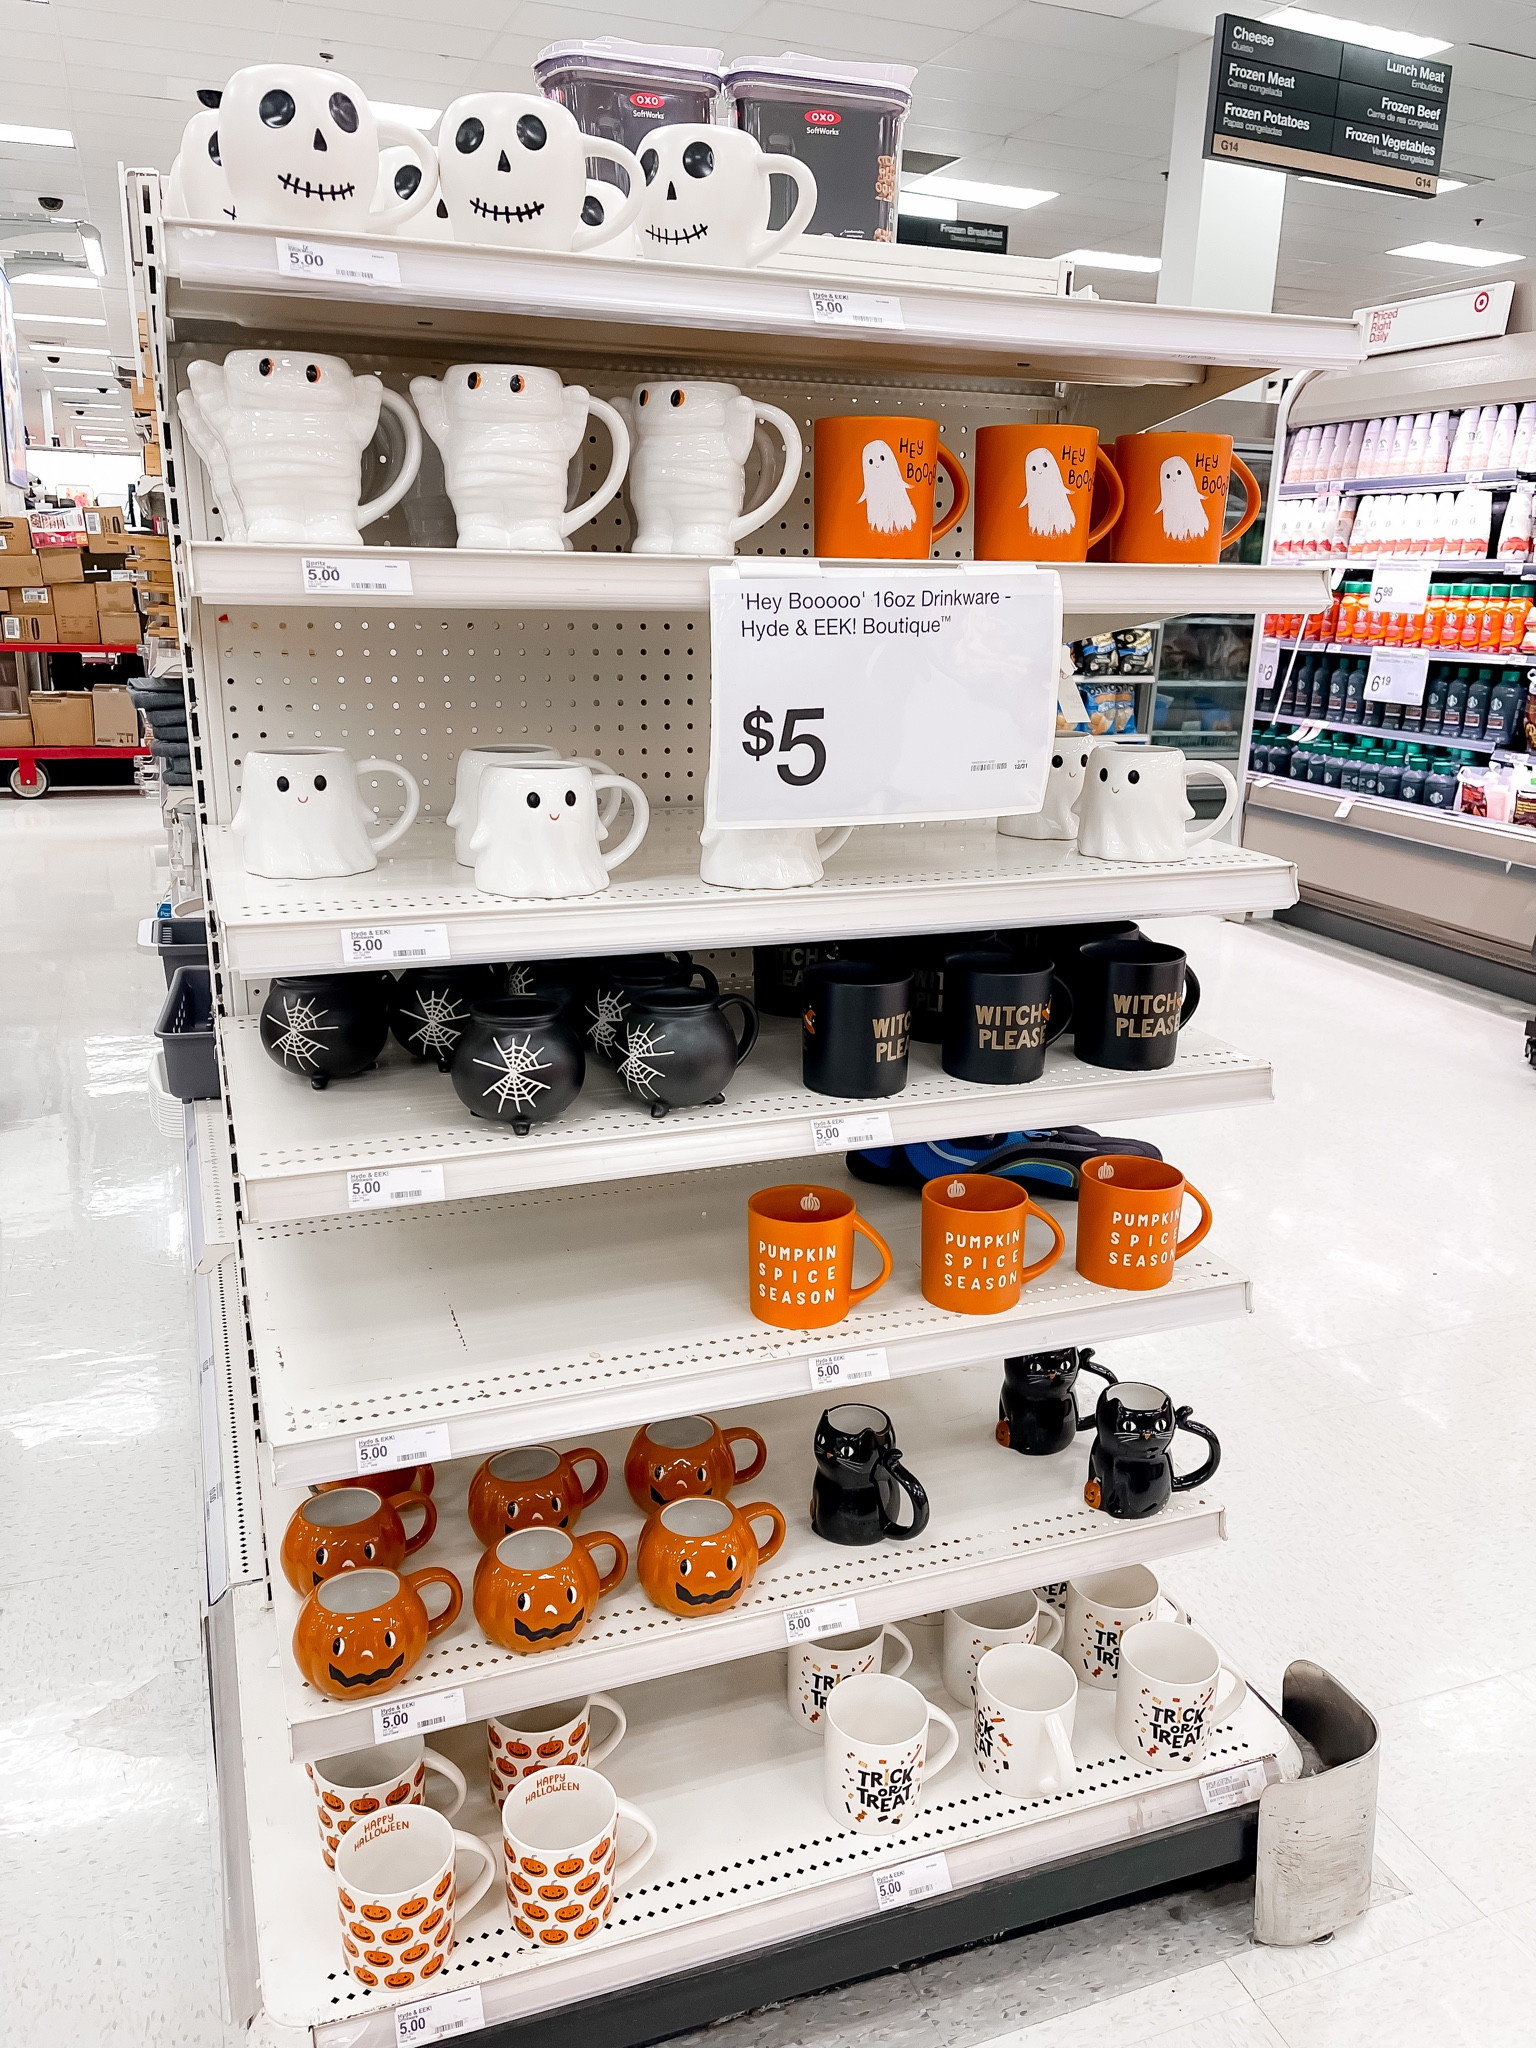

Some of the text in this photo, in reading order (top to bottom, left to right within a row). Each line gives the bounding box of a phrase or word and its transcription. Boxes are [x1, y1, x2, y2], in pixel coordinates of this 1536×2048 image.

[1233, 26, 1274, 47] Cheese
[1229, 62, 1295, 89] Frozen Meat
[1386, 59, 1446, 83] Lunch Meat
[636, 96, 659, 106] OXO
[1382, 96, 1442, 120] Frozen Beef
[632, 110, 664, 120] SoftWorks
[811, 112, 835, 123] OXO
[1225, 102, 1310, 131] Frozen Potatoes
[806, 126, 840, 136] SoftWorks
[1220, 140, 1238, 153] G14
[1346, 127, 1436, 156] Frozen Vegetables
[1416, 176, 1431, 189] G14
[940, 224, 966, 234] Frozen
[290, 252, 324, 266] 5.00
[816, 300, 842, 313] 5.00
[1373, 308, 1398, 322] Priced
[1369, 332, 1388, 343] Daily
[1371, 321, 1392, 334] Right
[900, 437, 924, 458] HEY
[1062, 444, 1086, 466] HEY
[1196, 452, 1218, 472] HEY
[308, 569, 340, 581] 5.00
[741, 592, 782, 614] 'Hey
[789, 591, 866, 610] Booooo'
[873, 590, 916, 608] 16oz
[922, 588, 1000, 606] Drinkware
[741, 619, 789, 642] Hyde
[795, 620, 808, 636] &
[814, 618, 856, 636] EEK!
[742, 705, 827, 786] $5
[353, 939, 382, 952] 5.00
[1113, 992, 1177, 1014] WITCH
[976, 1003, 1042, 1026] WITCH
[1116, 1012, 1180, 1038] PLEASE
[979, 1024, 1046, 1050] PLEASE
[816, 1128, 839, 1140] 5.00
[352, 1181, 380, 1194] 5.00
[1113, 1208, 1180, 1227] PUMPKIN
[945, 1229, 1020, 1250] PUMPKIN
[1111, 1226, 1178, 1247] SPICE
[759, 1240, 837, 1261] PUMPKIN
[945, 1250, 1019, 1270] SPICE
[1109, 1248, 1175, 1267] SEASON
[759, 1262, 836, 1282] SPICE
[945, 1270, 1018, 1290] SEASON
[759, 1284, 836, 1305] SEASON
[818, 1364, 840, 1377] 5.00
[361, 1446, 388, 1460] 5.00
[788, 1617, 810, 1630] 5.00
[382, 1712, 408, 1728] 5.00
[1152, 1706, 1206, 1724] TRICK
[1149, 1722, 1204, 1748] TREAT
[1170, 1724, 1194, 1734] OR
[536, 1773, 566, 1788] HAPPY
[858, 1766, 914, 1788] TRICK
[525, 1782, 580, 1804] HALLOWEEN
[856, 1782, 912, 1812] TREAT
[878, 1786, 902, 1797] OR
[364, 1813, 394, 1833] HAPPY
[354, 1821, 410, 1852] HALLOWEEN
[880, 1881, 901, 1896] 5.00
[400, 2018, 426, 2034] 5.00
